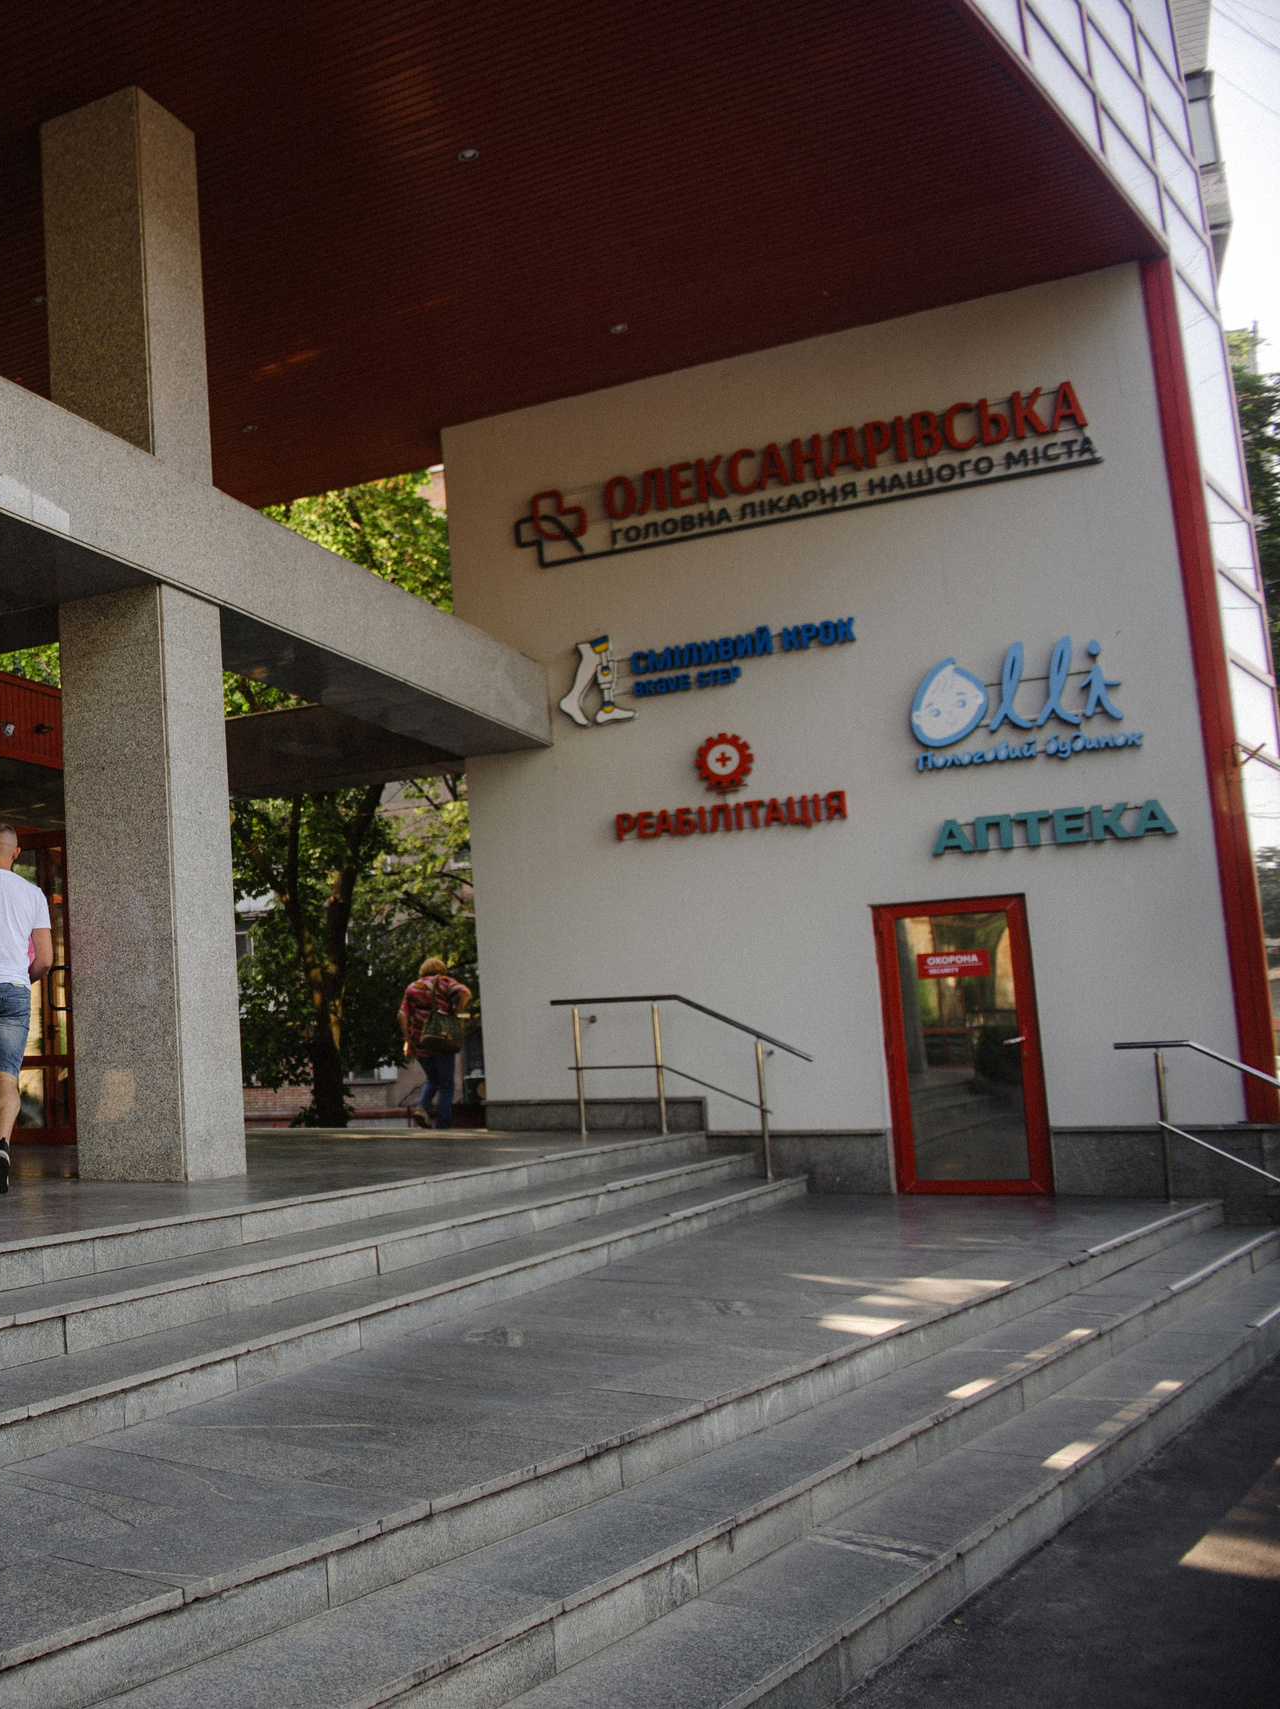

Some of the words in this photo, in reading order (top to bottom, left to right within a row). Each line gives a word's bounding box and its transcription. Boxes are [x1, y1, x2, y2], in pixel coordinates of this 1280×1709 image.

[604, 381, 1089, 520] ОЛЕКСАНДРІВСЬКА
[611, 508, 732, 546] ГОЛОВНА
[739, 482, 858, 521] ЛІКАРНЯ
[868, 455, 995, 495] НАШОГО
[1005, 436, 1097, 468] МІСТА
[631, 626, 773, 675] СМІЛИВИЙ
[782, 617, 856, 650] КРОК
[696, 665, 742, 688] STEP
[918, 737, 1037, 771] Пологовий
[1045, 731, 1144, 758] будинок
[616, 790, 847, 840] РЕАБІЛІТАЦІЯ
[932, 799, 1178, 856] АПТЕКА
[926, 954, 978, 966] ОХОРОНА
[928, 967, 959, 975] SECURITY
